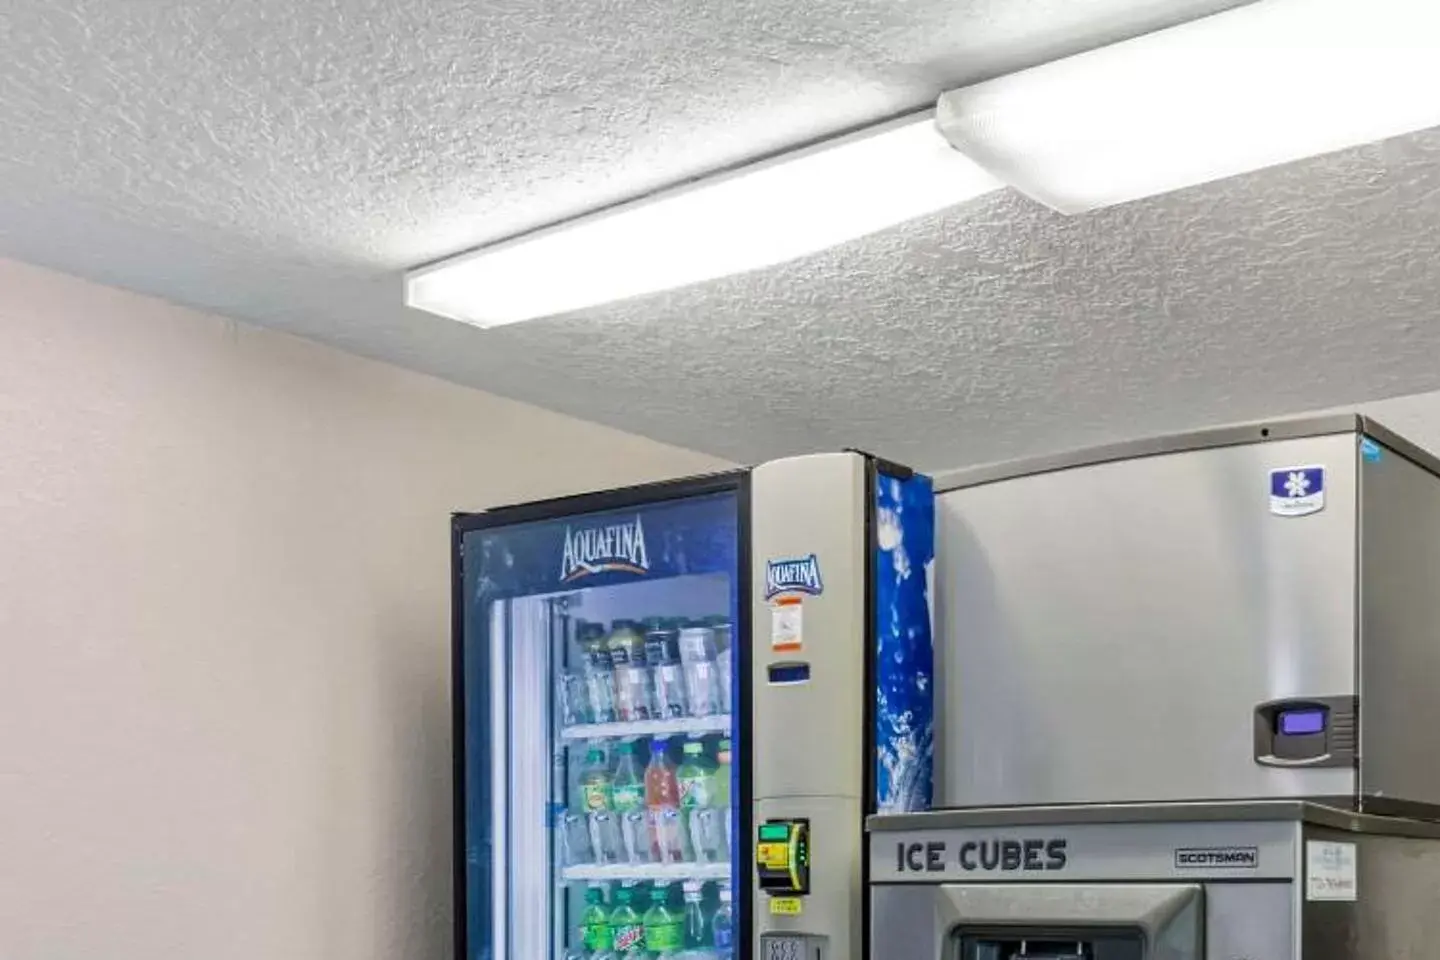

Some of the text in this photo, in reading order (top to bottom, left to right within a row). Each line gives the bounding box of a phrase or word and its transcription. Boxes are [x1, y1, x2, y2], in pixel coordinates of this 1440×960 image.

[560, 512, 650, 580] AQUAFINA
[896, 839, 1067, 872] ICE CUBES
[1178, 852, 1256, 864] SCOTSMAN
